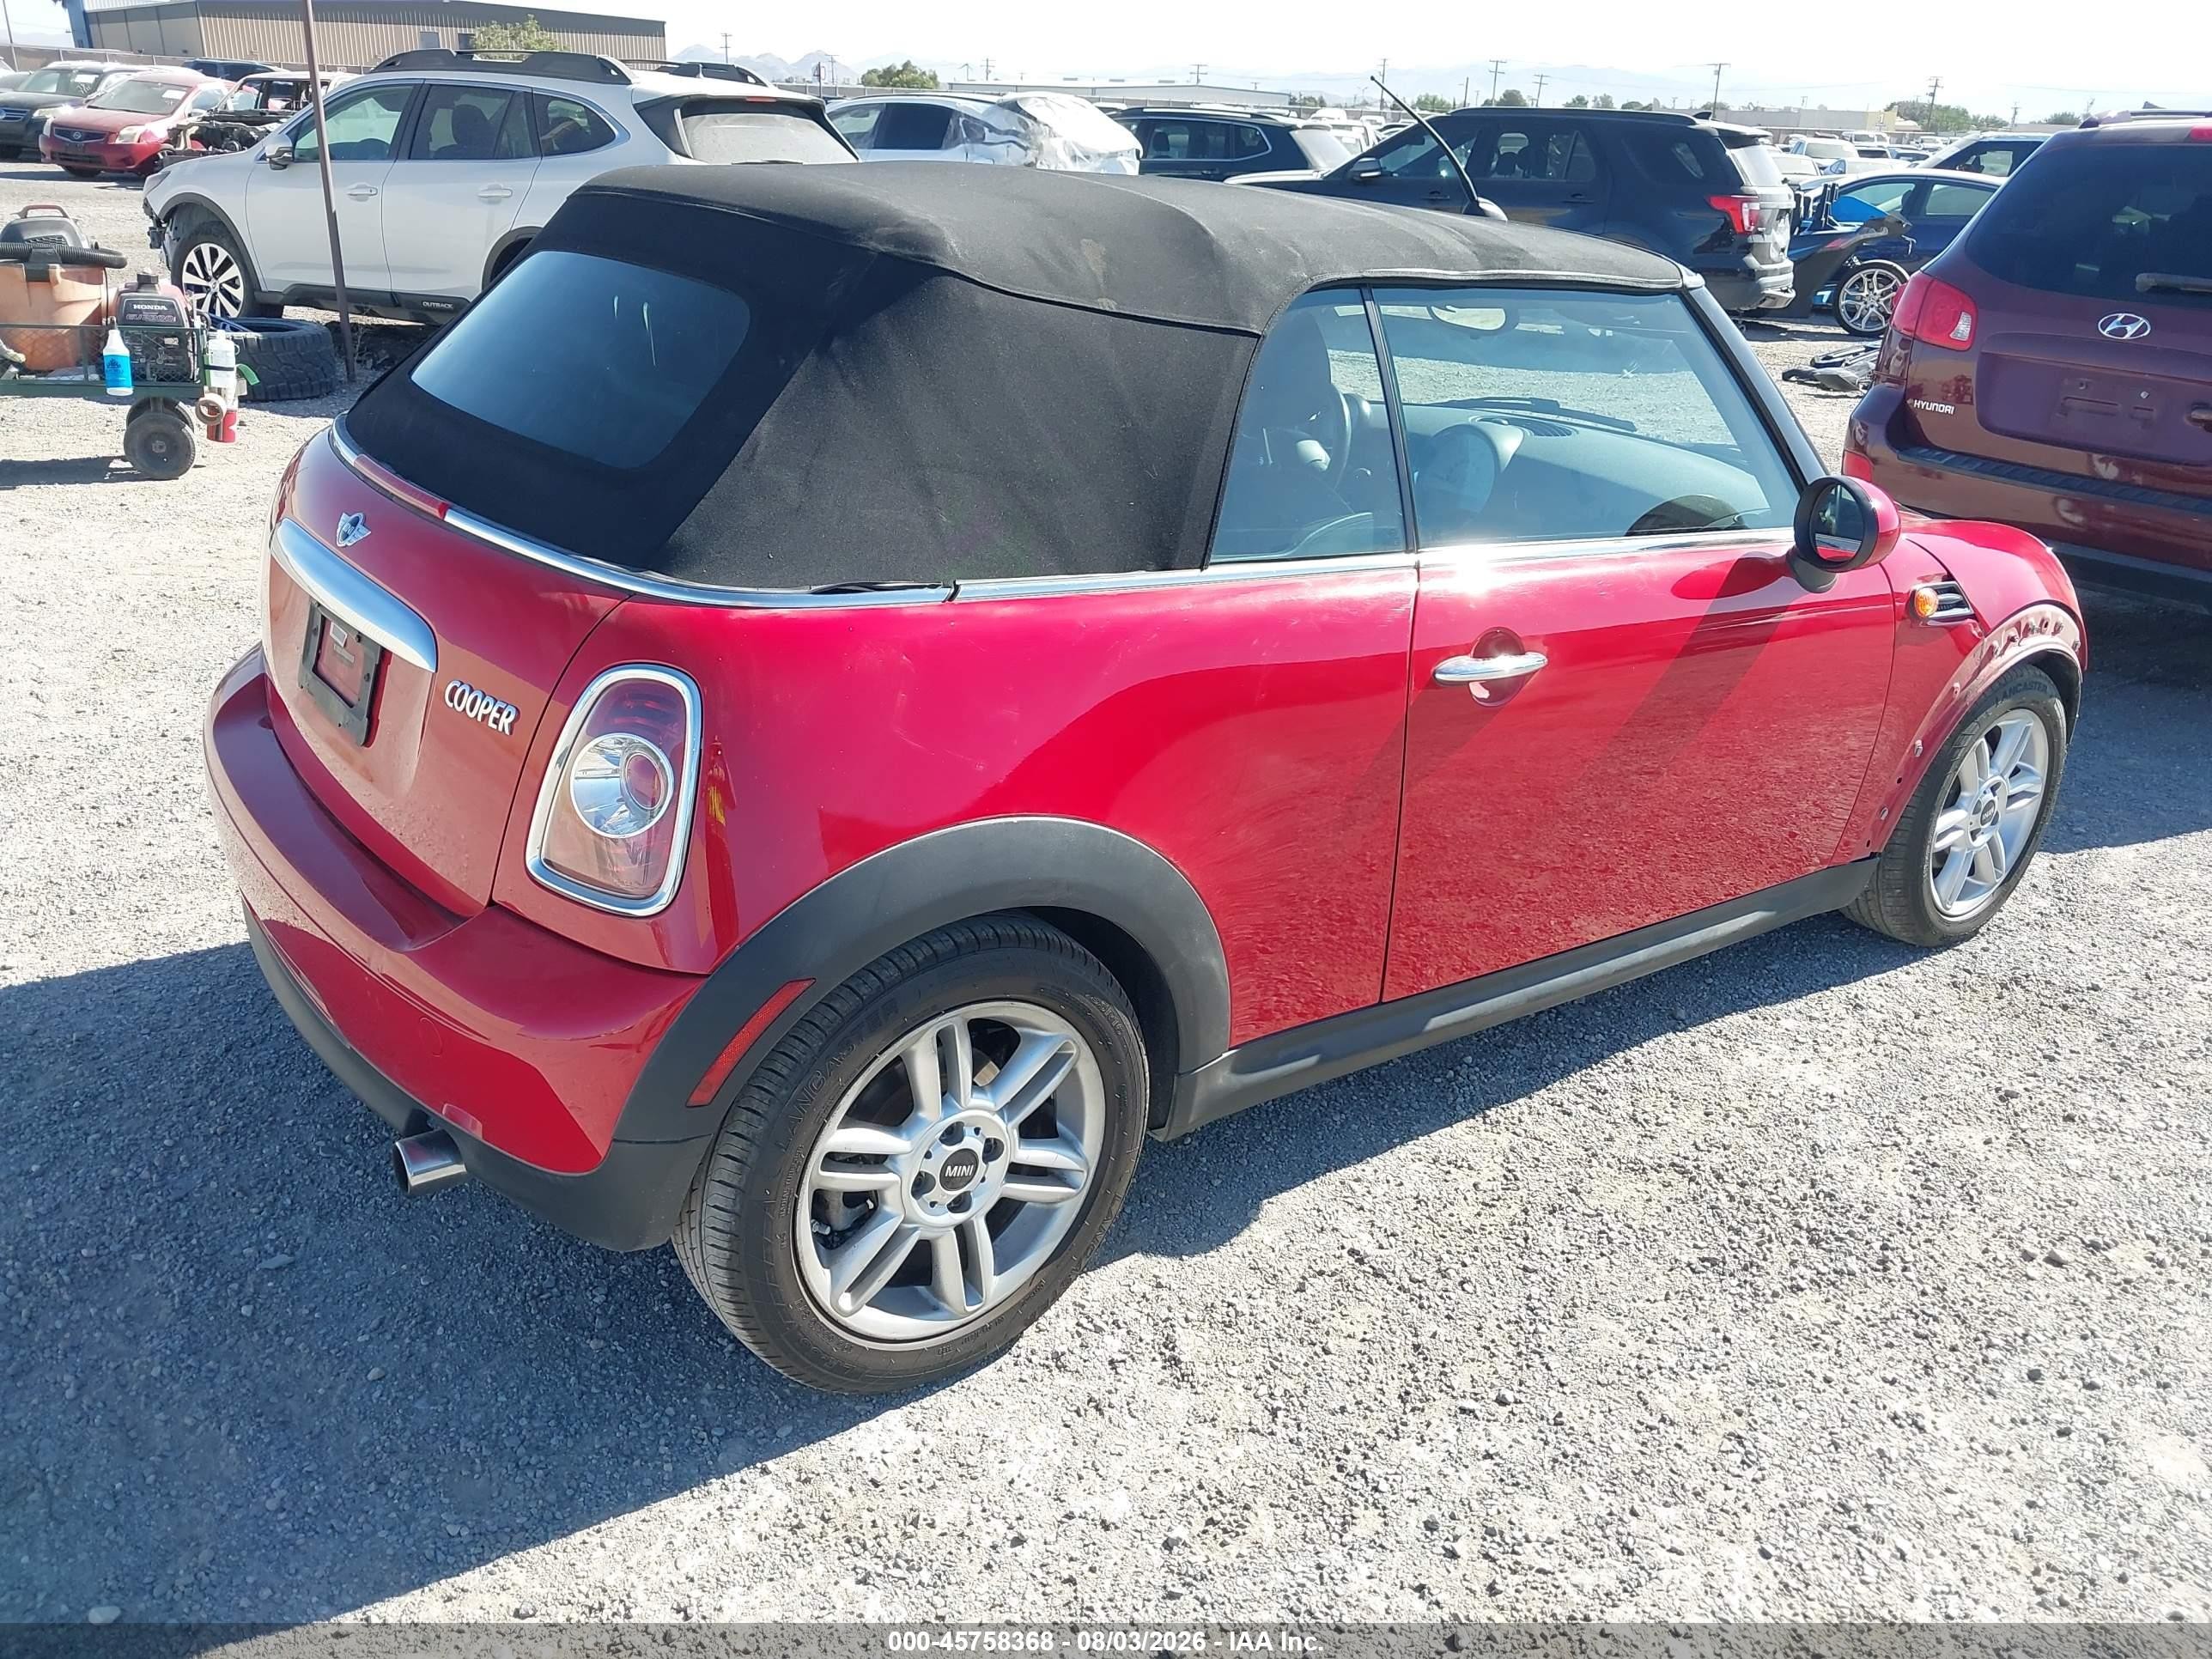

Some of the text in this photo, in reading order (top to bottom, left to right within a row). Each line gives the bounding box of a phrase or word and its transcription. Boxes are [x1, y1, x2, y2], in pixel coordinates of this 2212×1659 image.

[1913, 399, 1955, 415] HYUNDAI
[445, 679, 519, 736] COOPER
[945, 1164, 974, 1177] MINI
